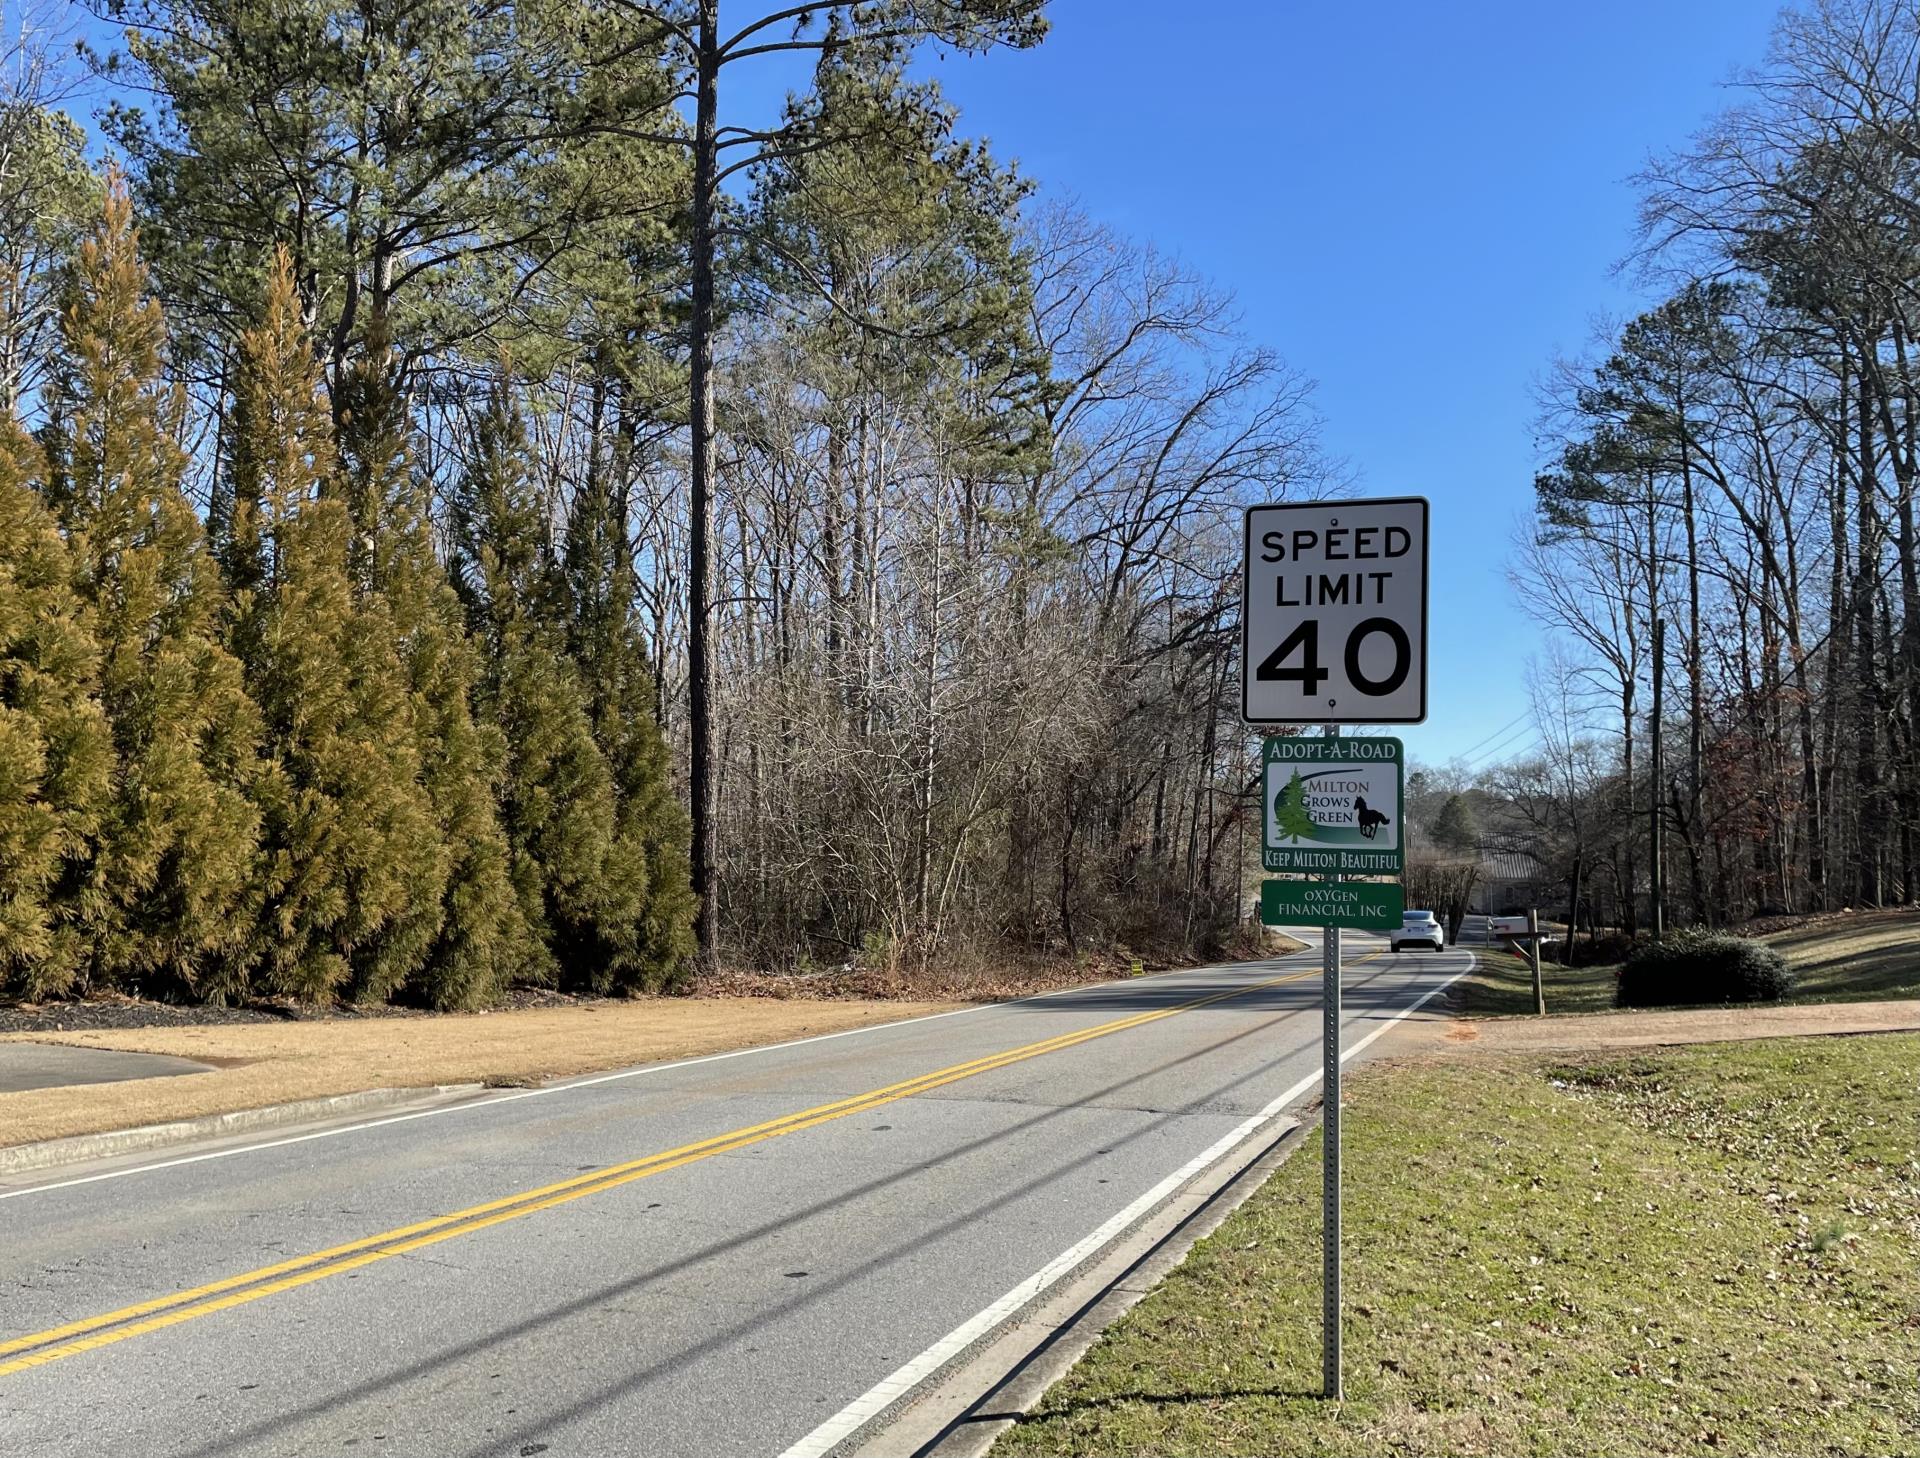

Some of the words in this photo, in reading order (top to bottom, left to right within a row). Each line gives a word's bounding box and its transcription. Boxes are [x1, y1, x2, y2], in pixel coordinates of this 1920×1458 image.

[1261, 526, 1411, 563] SPEED
[1276, 572, 1393, 607] LIMIT
[1256, 617, 1411, 697] 40
[1270, 741, 1396, 759] ADOPT-A-ROAD
[1308, 780, 1369, 793] MILTON
[1300, 794, 1350, 809] GROWS
[1306, 810, 1353, 823] GREEN
[1265, 850, 1291, 867] KEEP
[1293, 851, 1337, 868] MILTON
[1340, 852, 1400, 870] BEAUTIFUL
[1279, 904, 1356, 917] FINANCIAL,
[1360, 905, 1387, 917] INC
